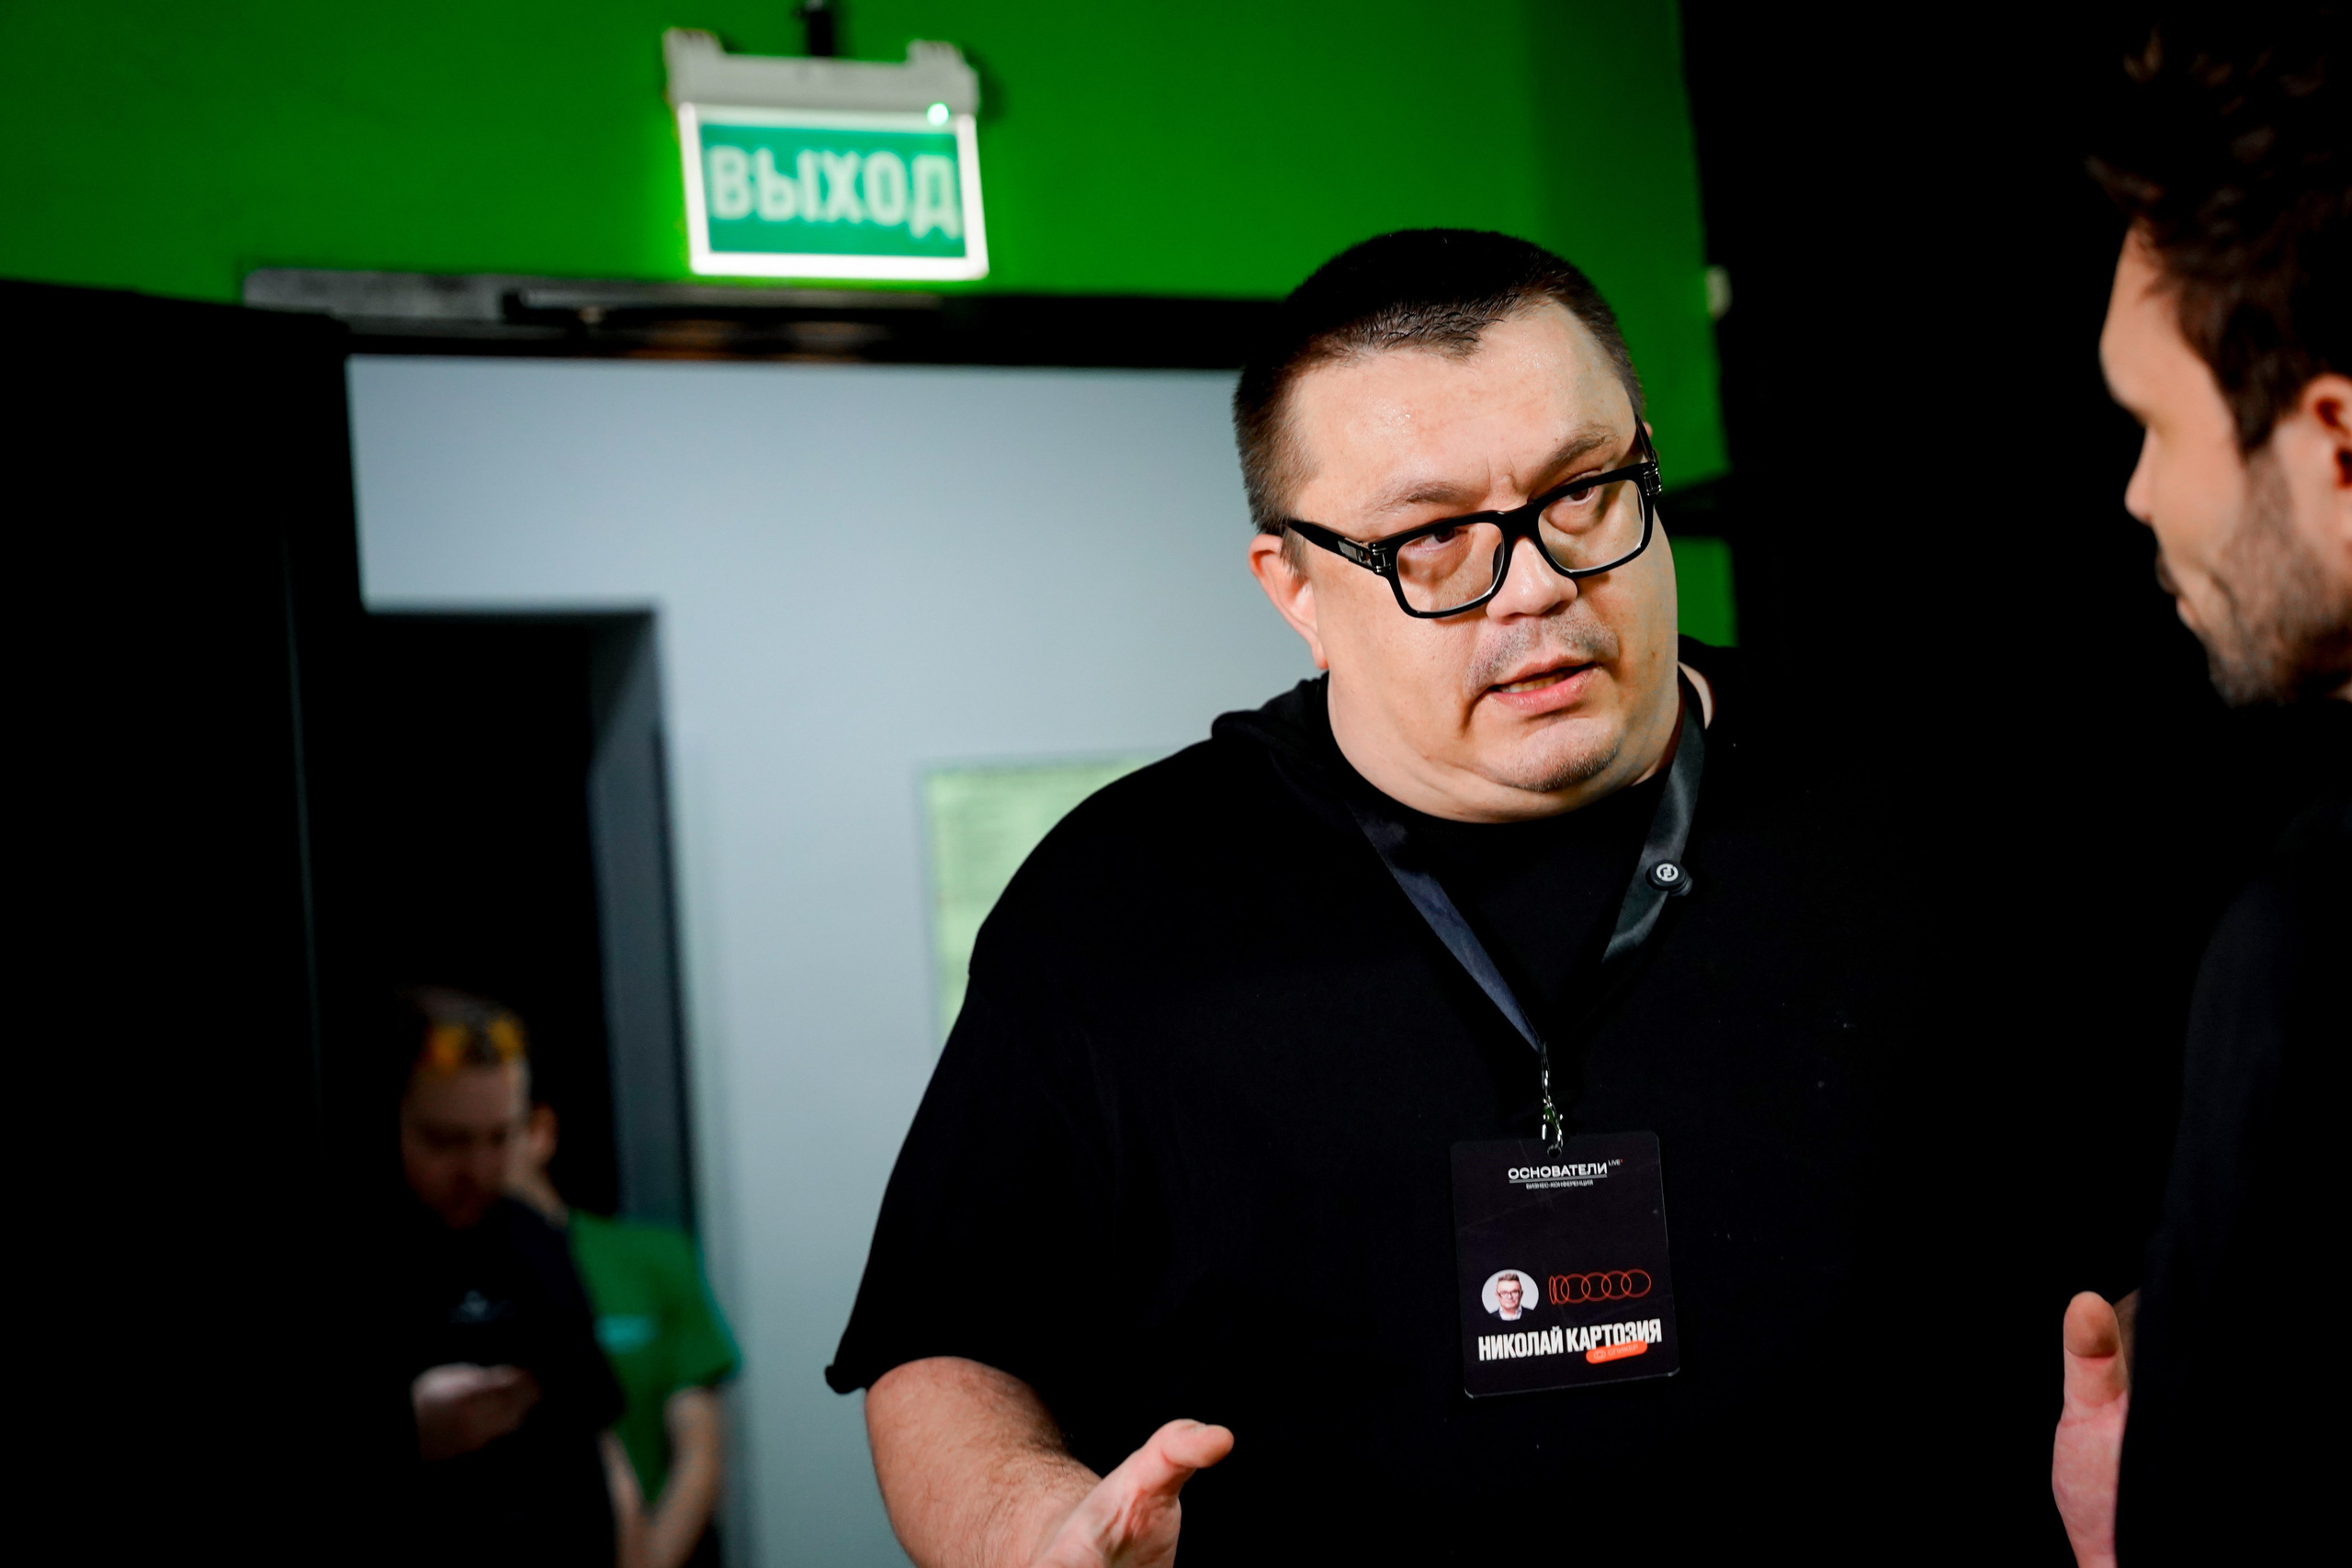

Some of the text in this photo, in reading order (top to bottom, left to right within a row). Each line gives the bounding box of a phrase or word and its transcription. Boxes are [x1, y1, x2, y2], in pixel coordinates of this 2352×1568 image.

[707, 144, 962, 240] ВЫХОД
[1508, 1162, 1608, 1180] ОСНОВАТЕЛИ
[1478, 1318, 1663, 1361] НИКОЛАЙ КАРТОЗИЯ
